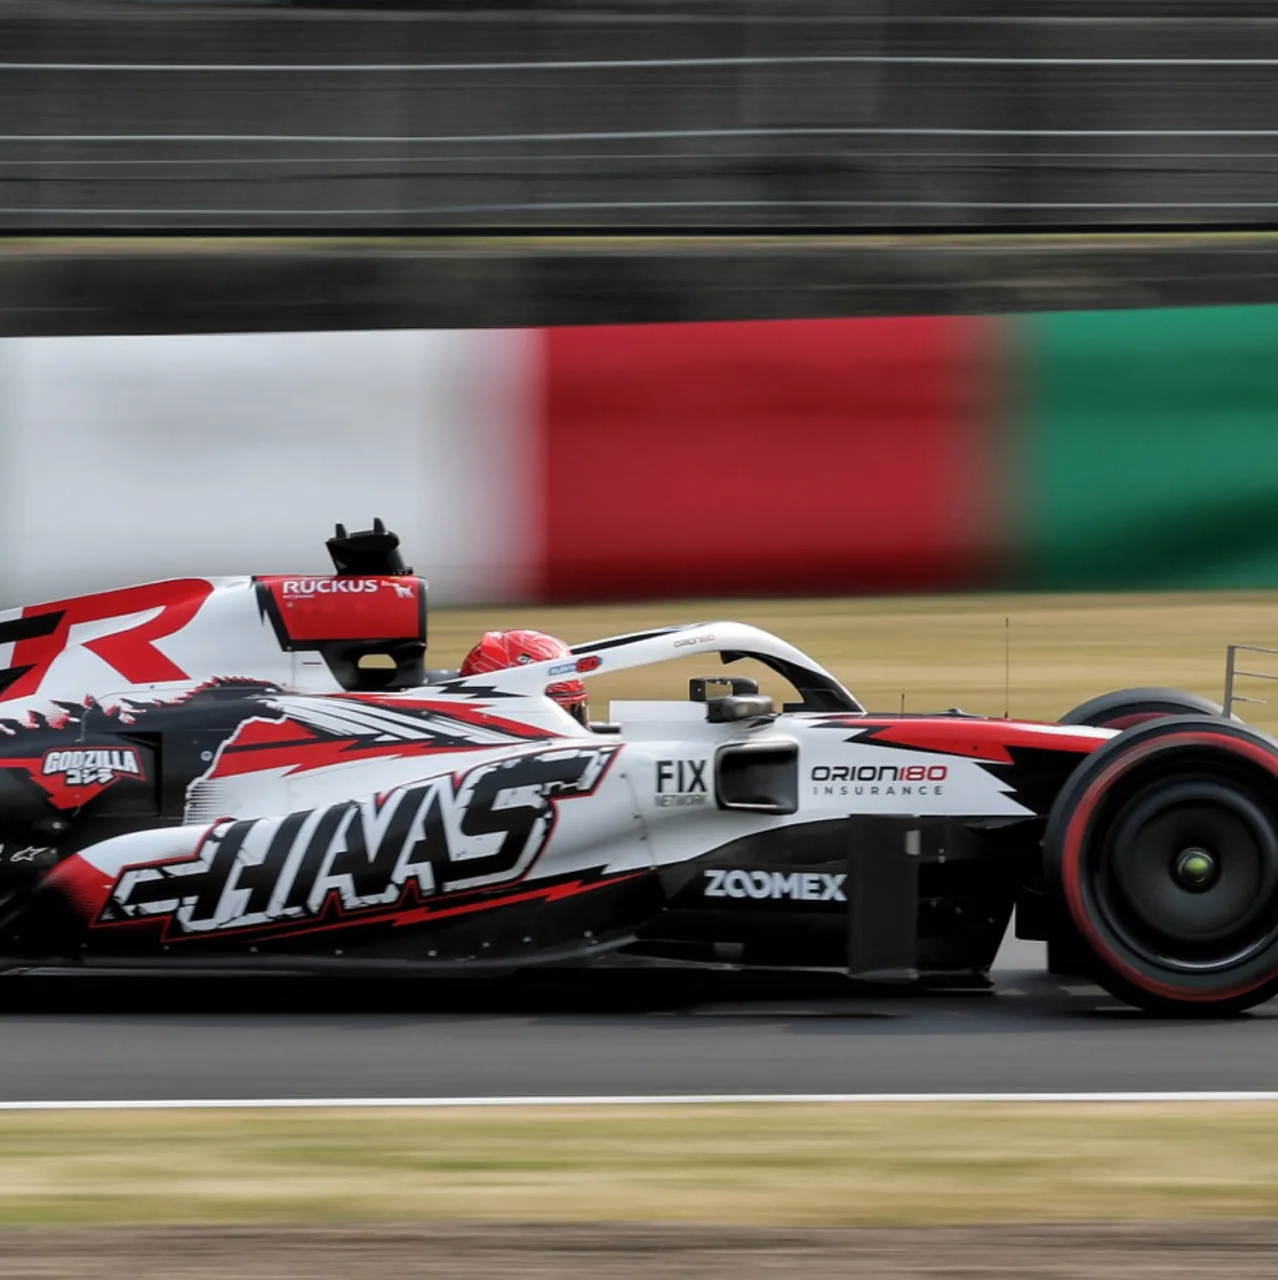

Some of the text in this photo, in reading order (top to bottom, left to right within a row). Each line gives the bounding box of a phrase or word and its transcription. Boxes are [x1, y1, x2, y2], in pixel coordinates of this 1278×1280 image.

[282, 579, 378, 594] RUCKUS
[43, 750, 139, 774] GODZILLA
[811, 766, 948, 781] ORION180
[656, 760, 707, 793] FIX
[813, 786, 943, 795] INSURANCE
[106, 746, 611, 932] HAAS
[704, 870, 848, 901] ZOOMEX
